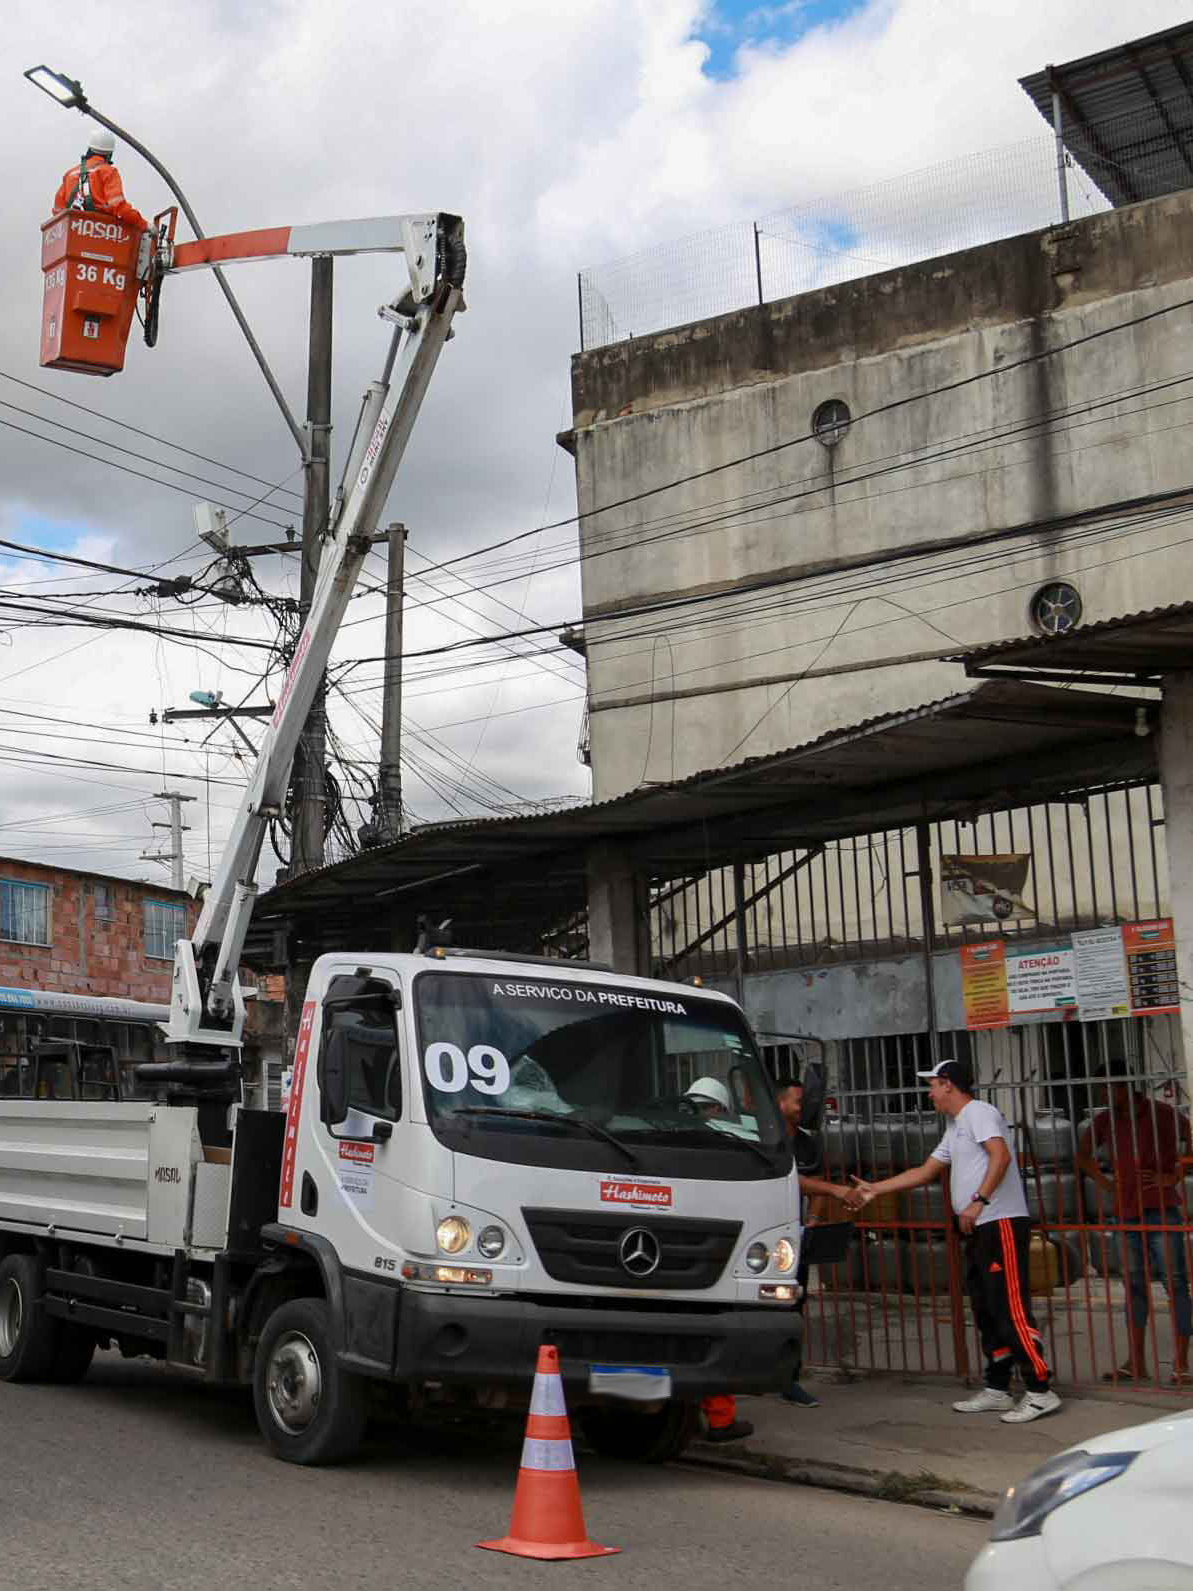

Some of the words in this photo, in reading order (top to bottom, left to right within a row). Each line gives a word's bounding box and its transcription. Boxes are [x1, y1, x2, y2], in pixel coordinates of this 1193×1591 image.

[71, 219, 131, 243] MASAL
[76, 263, 97, 282] 36
[102, 267, 126, 291] Kg
[1017, 954, 1060, 969] ATENÇÃO
[492, 983, 505, 996] A
[575, 989, 598, 1003] DA
[598, 991, 687, 1016] PREFEITURA
[424, 1041, 511, 1096] 09
[602, 1183, 670, 1203] Hashimoto
[374, 1256, 396, 1271] 815
